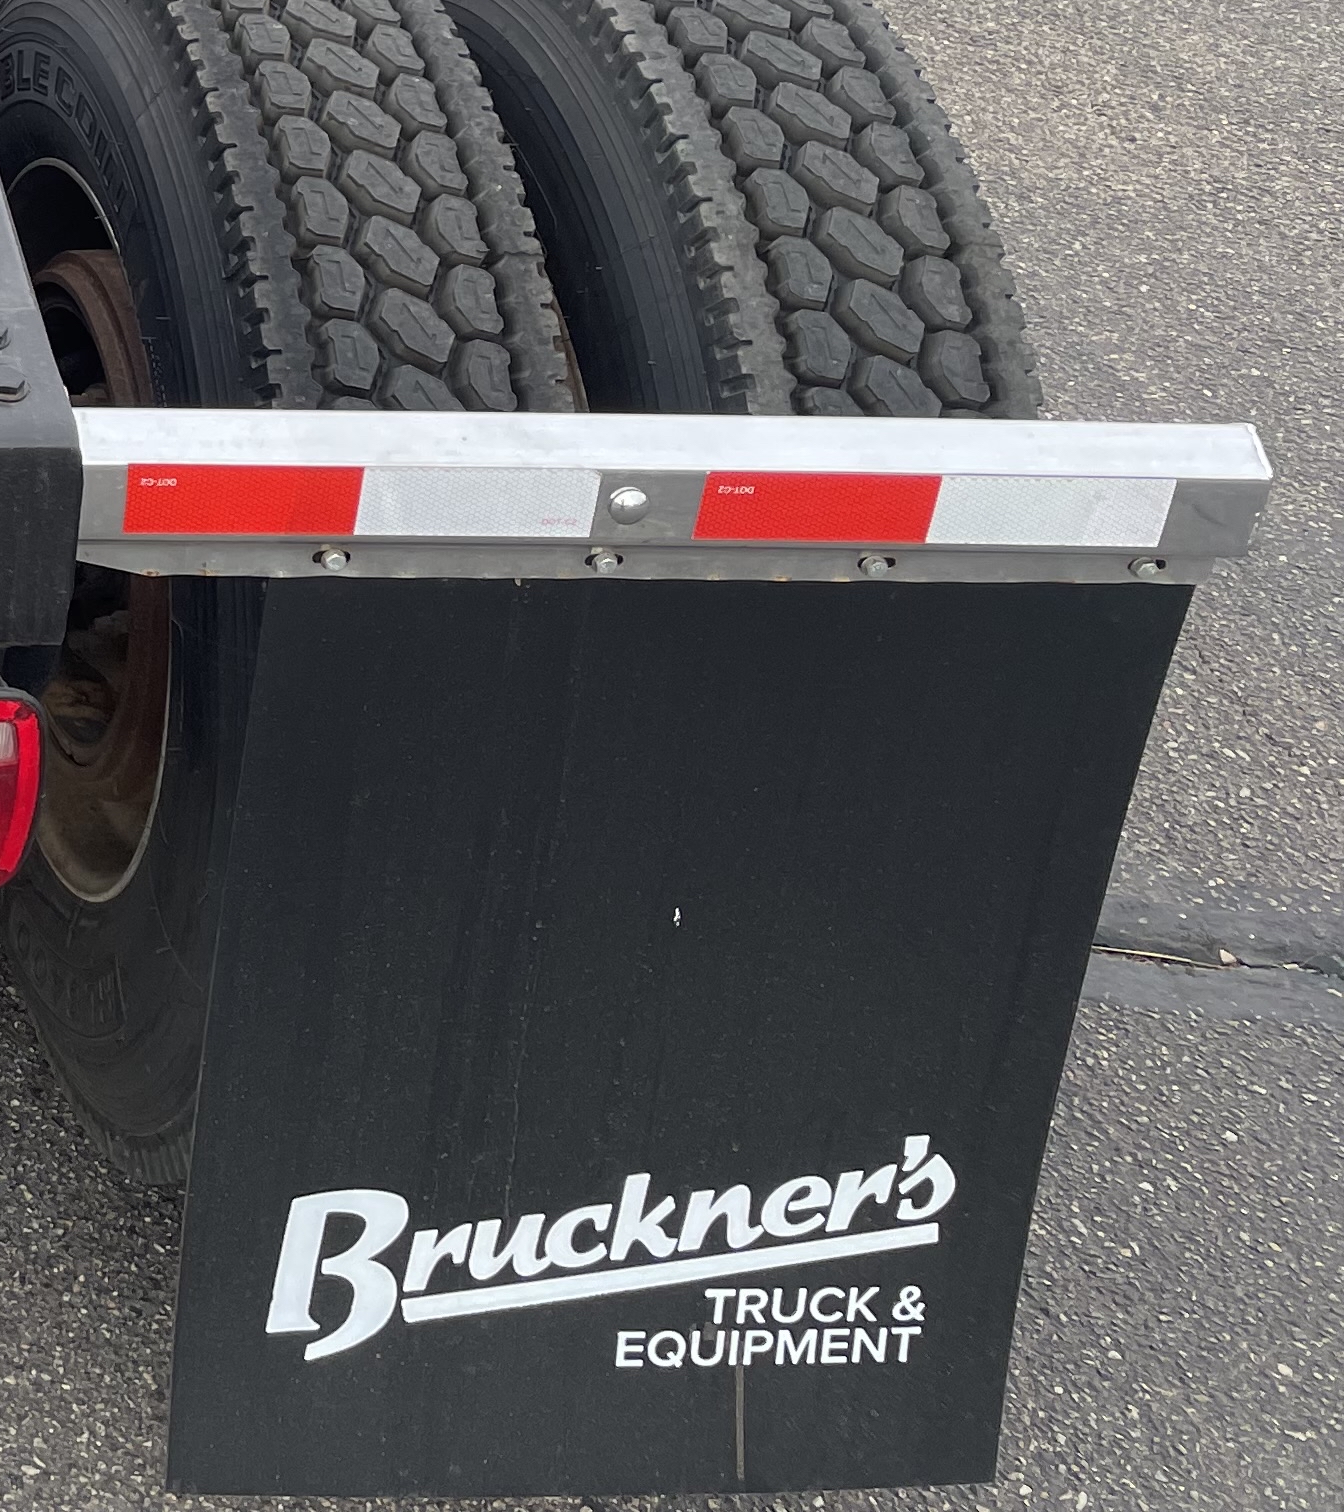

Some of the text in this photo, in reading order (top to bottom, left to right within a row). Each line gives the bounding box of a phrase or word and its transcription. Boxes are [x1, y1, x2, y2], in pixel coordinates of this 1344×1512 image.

[140, 477, 178, 487] DOT-C2
[717, 484, 755, 495] DOT-C2
[266, 1134, 957, 1361] Bruckner's
[705, 1285, 926, 1325] TRUCK &
[615, 1325, 922, 1368] EQUIPMENT
